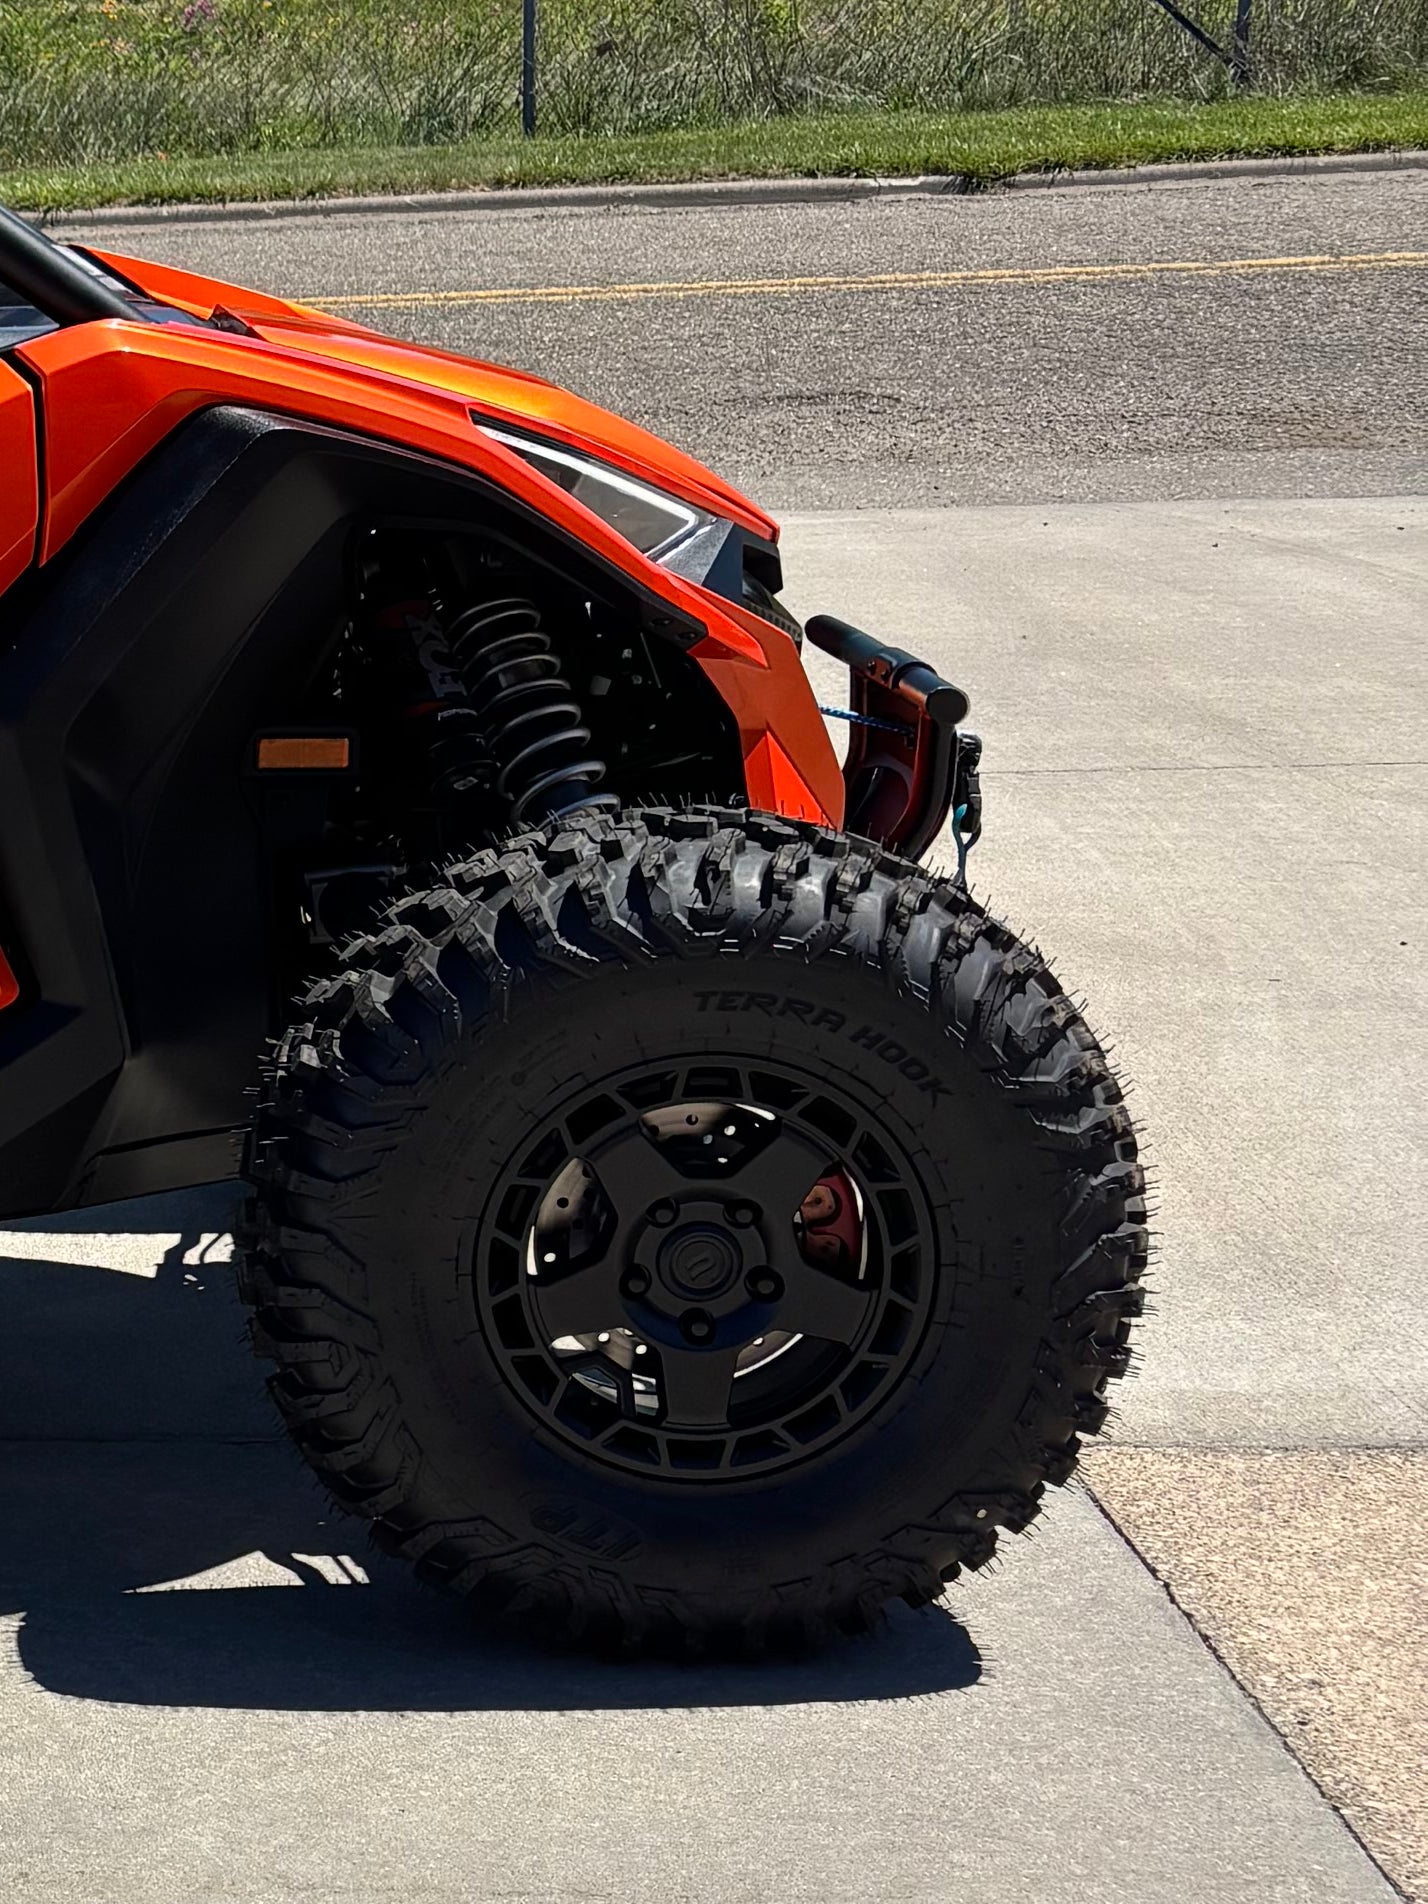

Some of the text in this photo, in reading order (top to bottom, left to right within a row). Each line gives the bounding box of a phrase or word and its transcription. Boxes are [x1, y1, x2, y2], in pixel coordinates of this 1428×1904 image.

[404, 613, 468, 699] FOX
[693, 990, 955, 1110] TERRA HOOK
